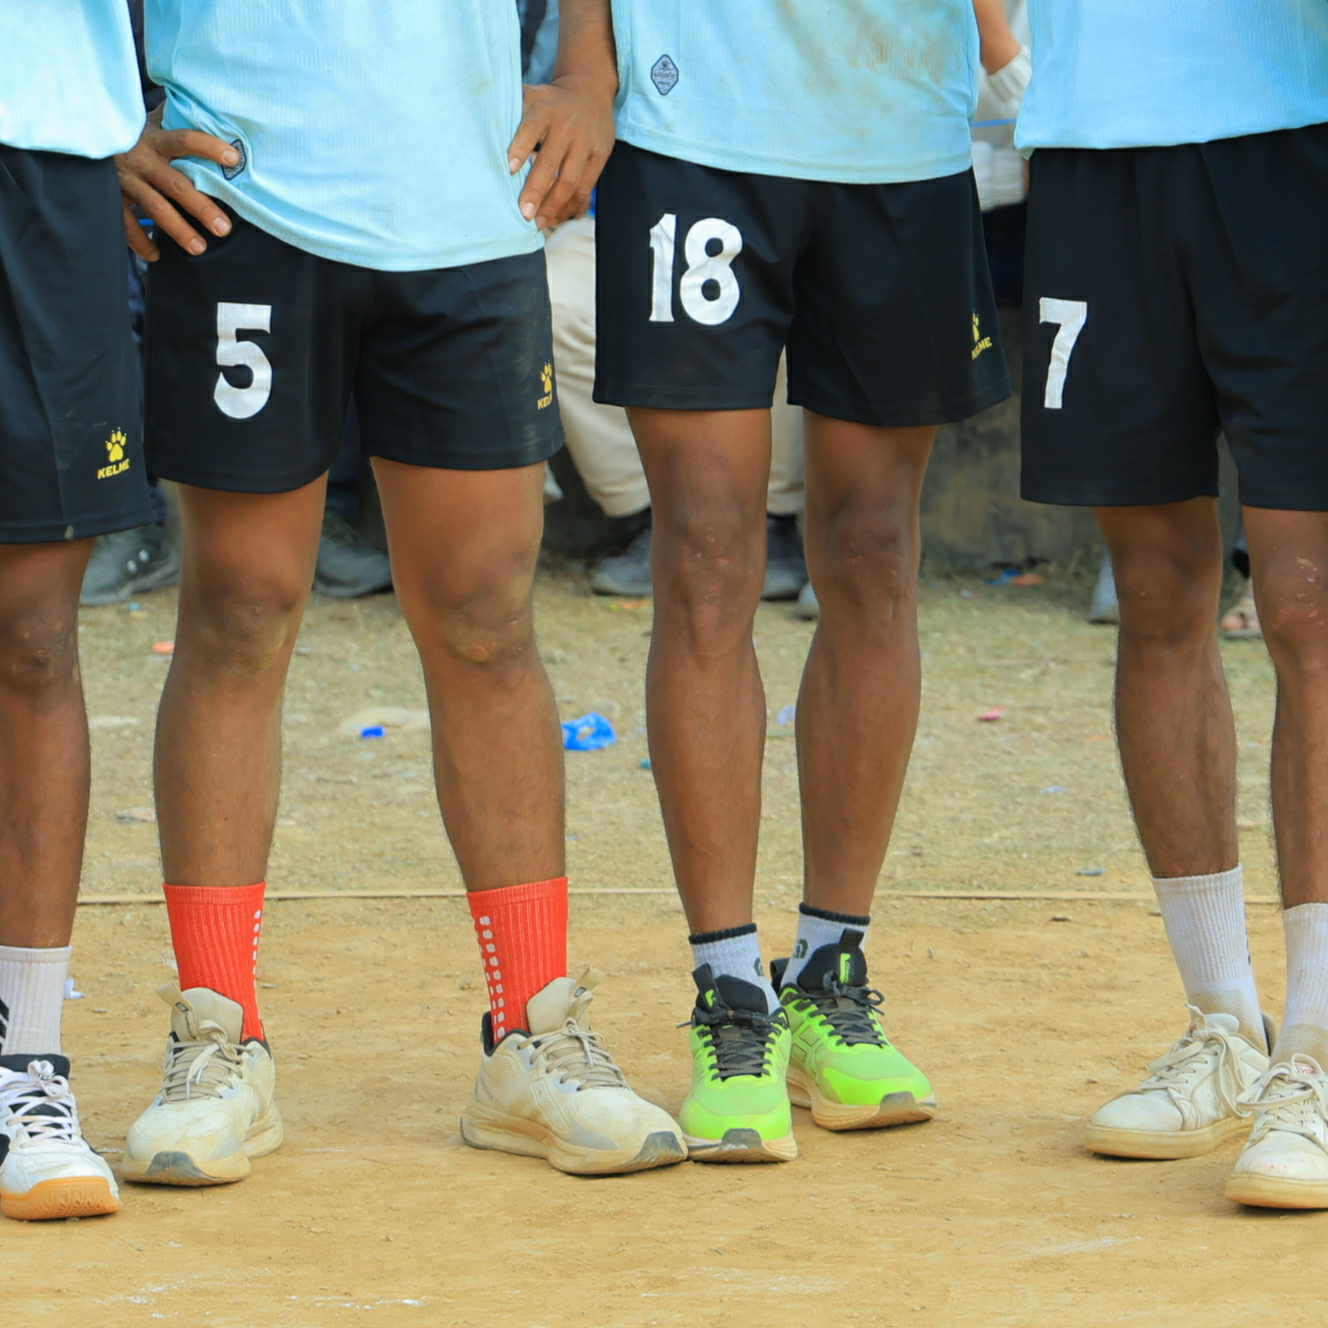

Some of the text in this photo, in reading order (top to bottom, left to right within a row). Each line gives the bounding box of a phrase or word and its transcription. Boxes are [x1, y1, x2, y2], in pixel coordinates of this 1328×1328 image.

[649, 213, 743, 326] 18
[213, 302, 273, 419] 5
[1039, 297, 1088, 410] 7
